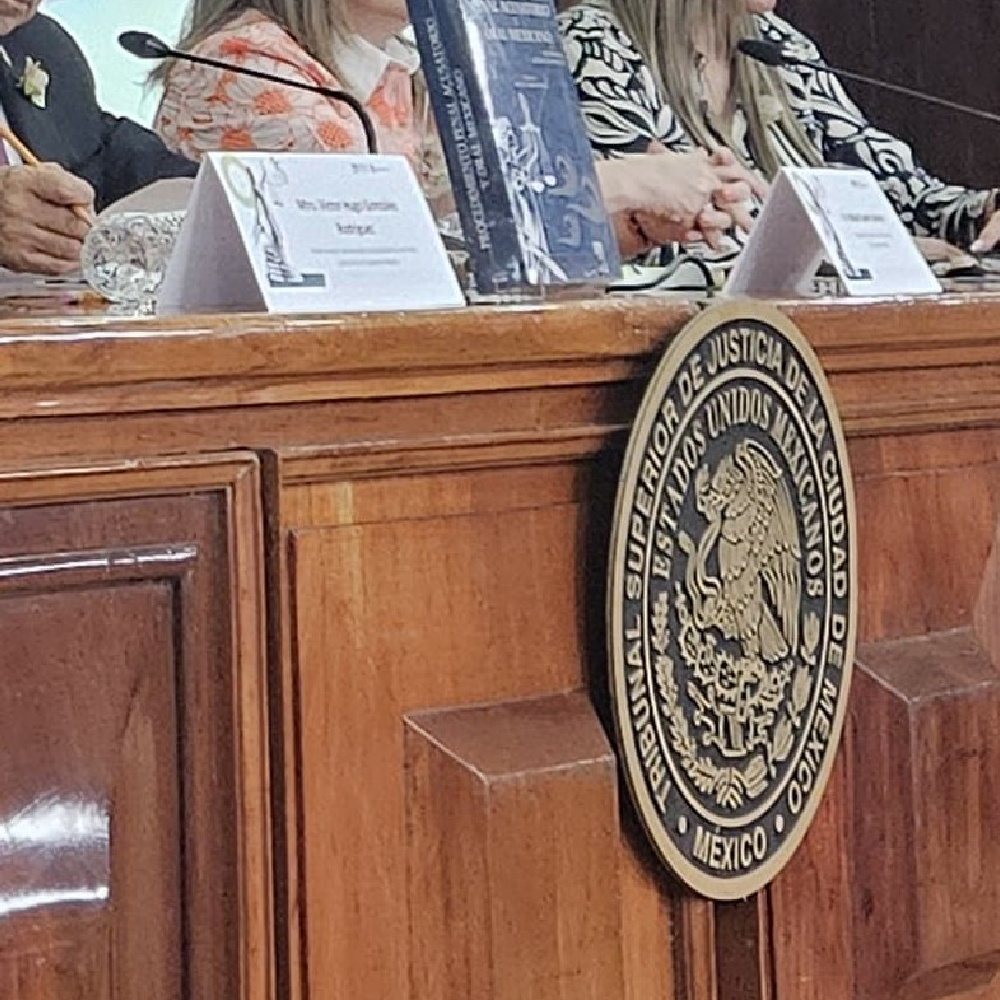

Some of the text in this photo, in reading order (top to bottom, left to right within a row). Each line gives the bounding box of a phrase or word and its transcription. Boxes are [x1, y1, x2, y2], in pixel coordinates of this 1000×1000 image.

[678, 352, 704, 407] DE
[706, 327, 783, 377] JUSTICIA
[785, 355, 810, 409] DE
[804, 397, 827, 450] LA
[624, 398, 680, 600] SUPERIOR
[651, 386, 825, 598] ESTADOS UNIDOS MEXICANOS
[822, 450, 849, 599] CIUDAD
[827, 613, 845, 668] DE
[624, 613, 671, 814] TRIBUNAL
